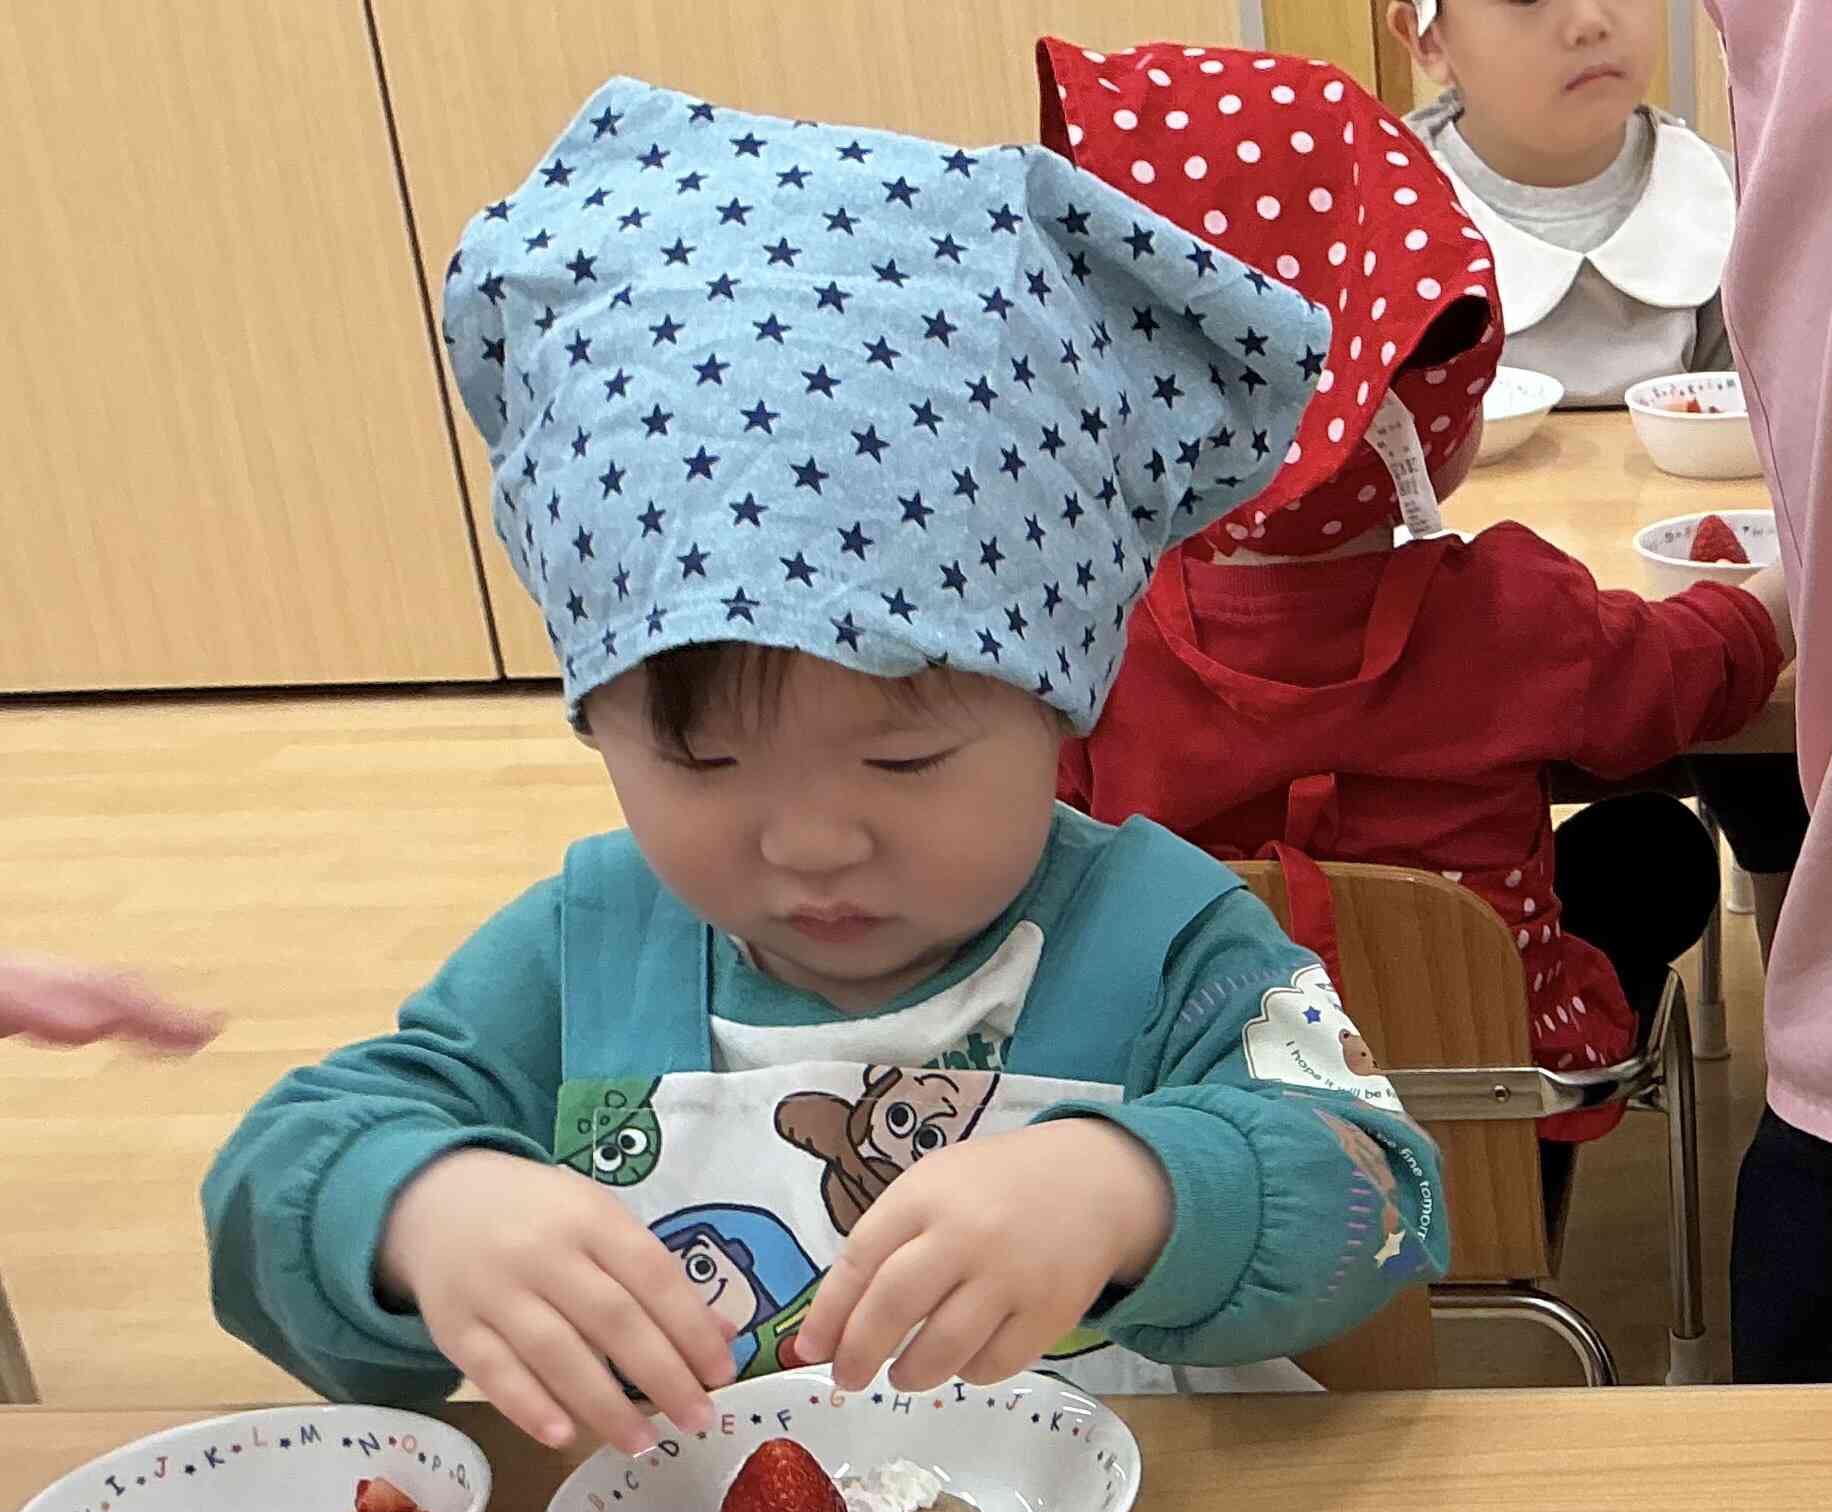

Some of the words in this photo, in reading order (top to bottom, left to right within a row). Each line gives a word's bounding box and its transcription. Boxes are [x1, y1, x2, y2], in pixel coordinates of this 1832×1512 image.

[1291, 1050, 1322, 1080] hope
[1365, 1089, 1382, 1099] be
[106, 1476, 125, 1495] I
[155, 1456, 169, 1478] J
[205, 1448, 224, 1468] K
[252, 1426, 268, 1447] L
[300, 1425, 322, 1444] M
[358, 1432, 381, 1456] N
[402, 1434, 416, 1454] O
[431, 1455, 441, 1471] P
[626, 1470, 639, 1489] C
[658, 1440, 680, 1457] D
[721, 1414, 735, 1434] E
[777, 1409, 792, 1431] F
[830, 1390, 846, 1408] G
[893, 1393, 912, 1414] H
[953, 1382, 965, 1402] I
[1006, 1393, 1024, 1411] J
[1050, 1411, 1063, 1432] K
